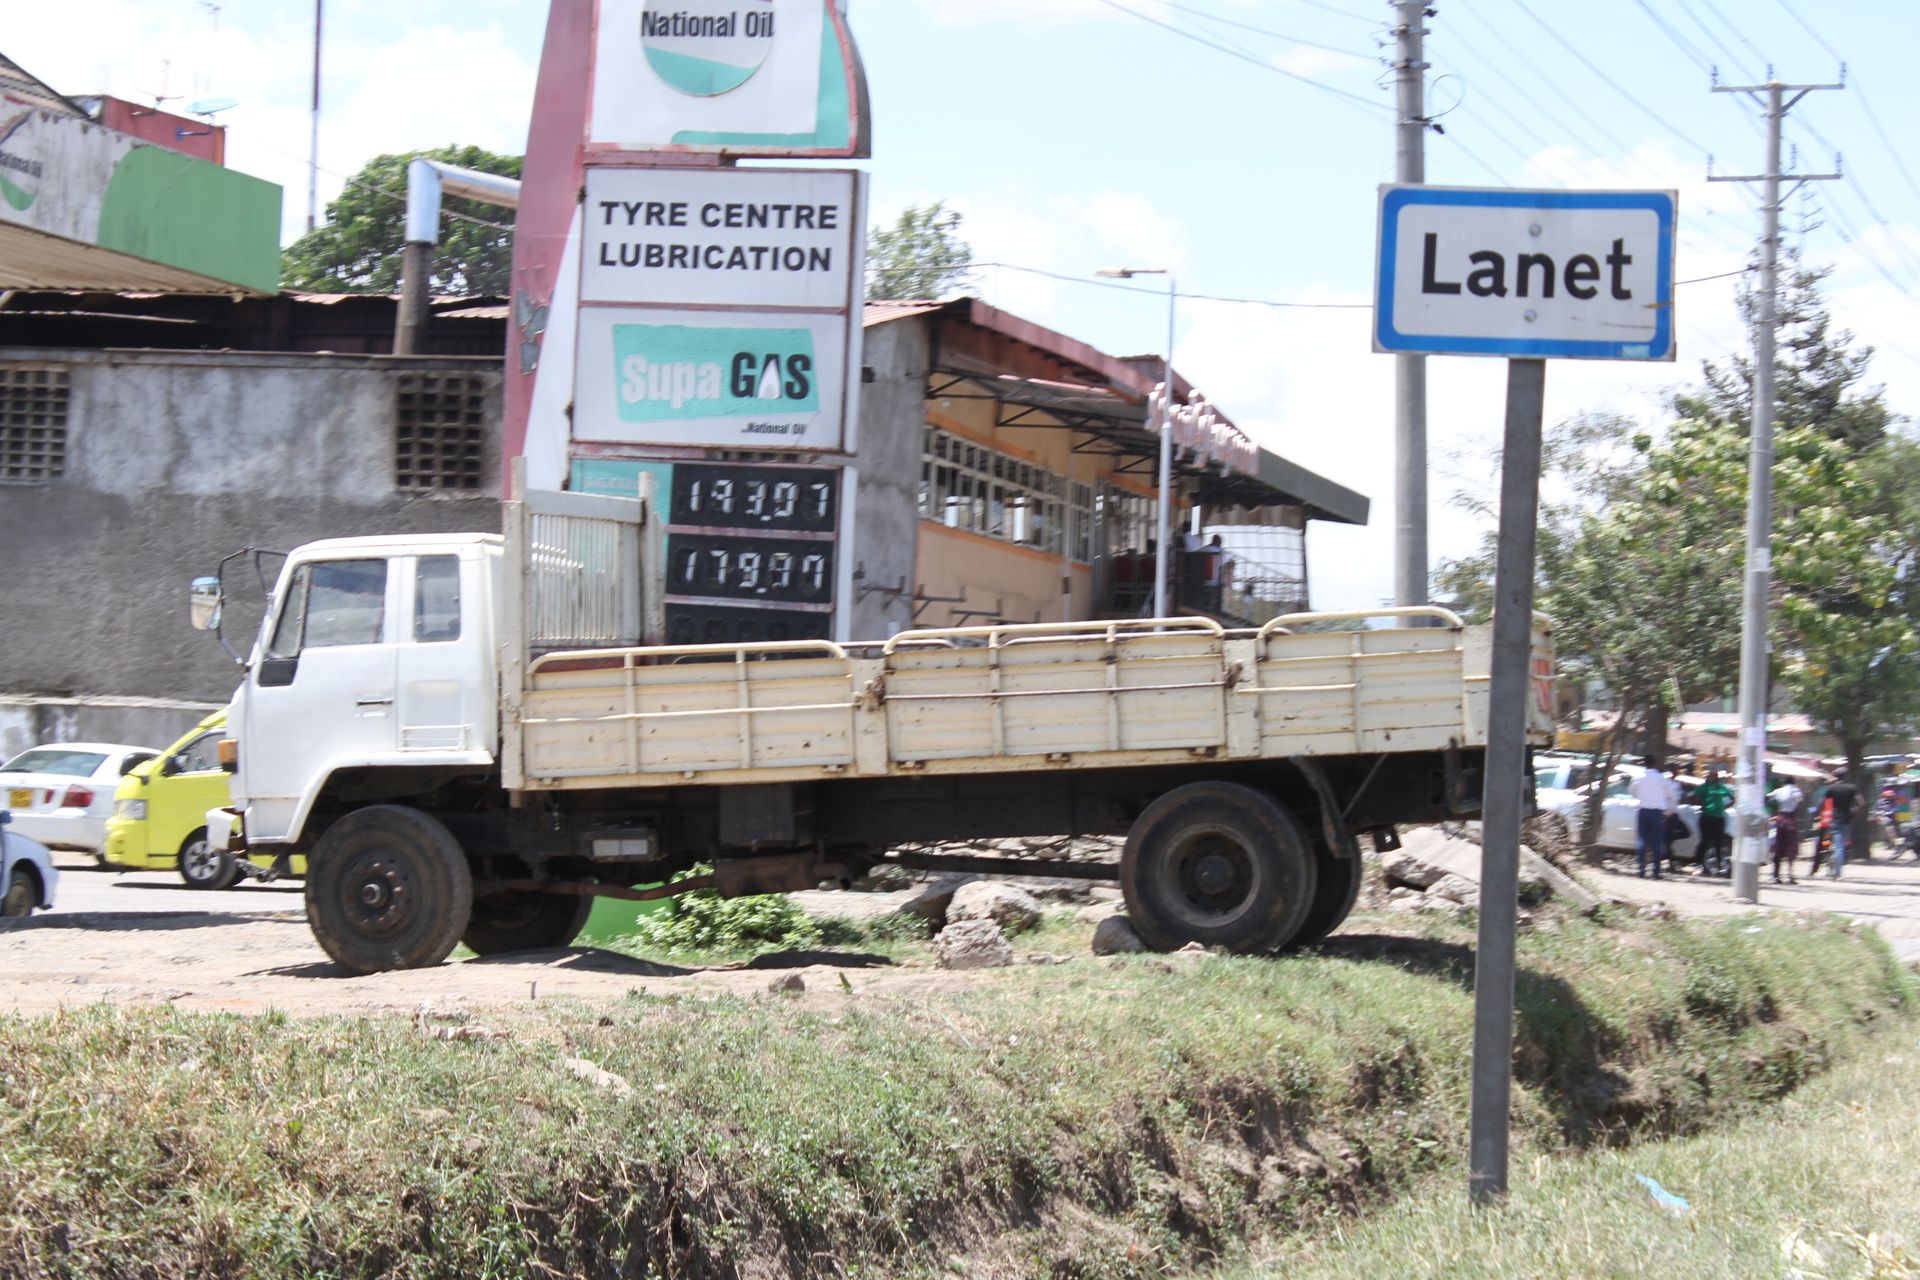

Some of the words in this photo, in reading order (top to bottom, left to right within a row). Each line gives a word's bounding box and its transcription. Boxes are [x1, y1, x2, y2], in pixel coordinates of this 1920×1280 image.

[641, 11, 736, 37] National
[745, 11, 774, 37] Oil
[599, 201, 688, 227] TYRE
[701, 203, 838, 230] CENTRE
[599, 242, 832, 272] LUBRICATION
[1422, 232, 1633, 301] Lanet
[621, 353, 722, 409] Supa
[731, 352, 812, 400] GAS
